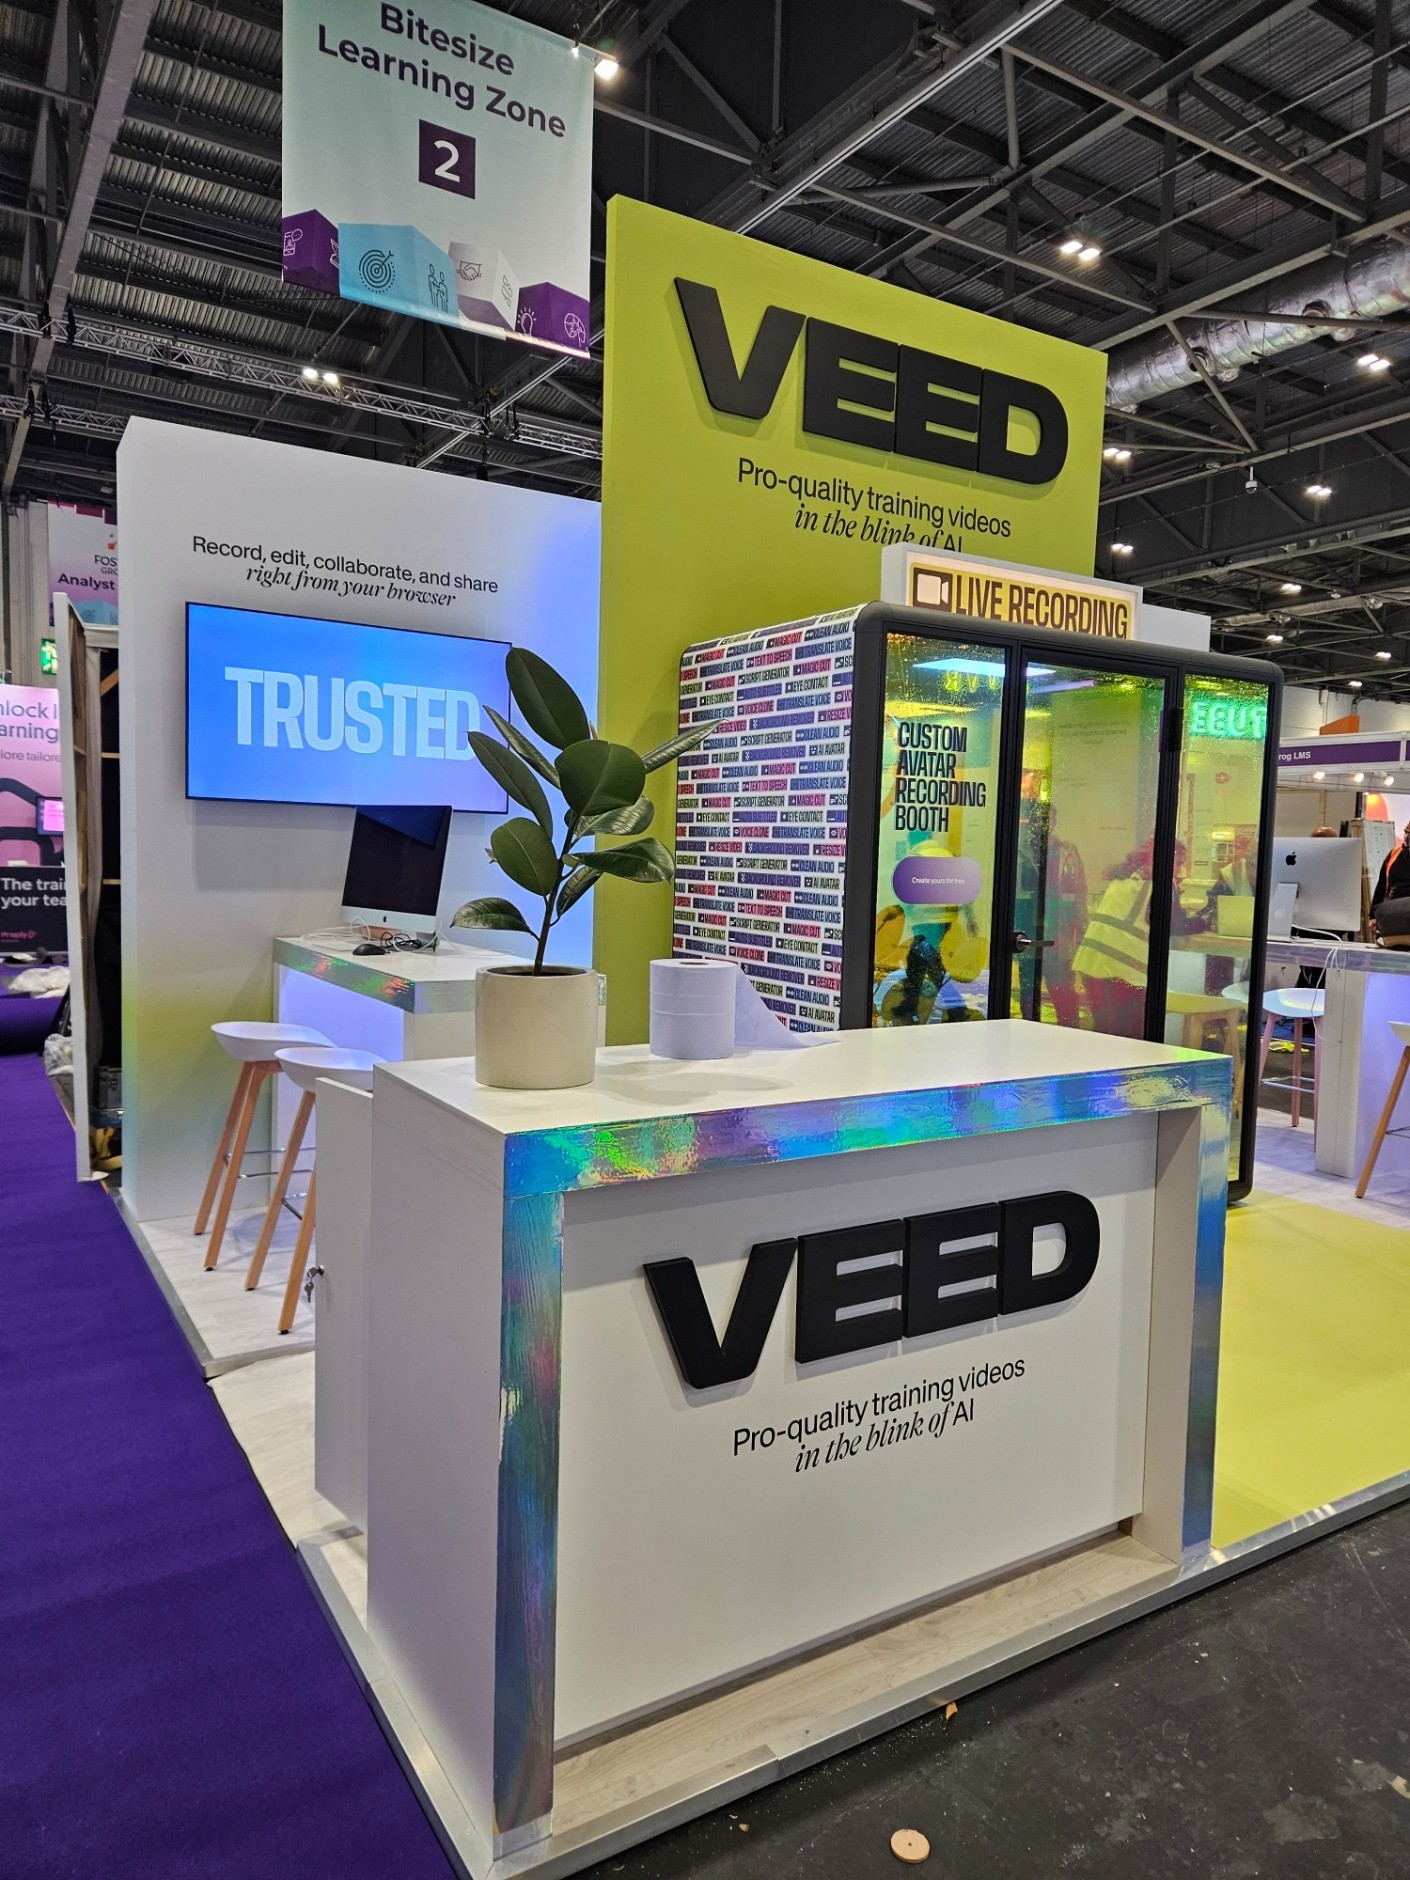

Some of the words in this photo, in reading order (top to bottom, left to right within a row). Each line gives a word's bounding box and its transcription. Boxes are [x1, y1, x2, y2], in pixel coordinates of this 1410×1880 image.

[381, 2, 514, 76] Bitesize
[318, 24, 474, 110] Learning
[486, 84, 566, 138] Zone
[434, 140, 460, 183] 2
[674, 277, 1068, 485] VEED
[738, 457, 864, 511] Pro-quality
[868, 486, 944, 528] training
[948, 506, 1011, 537] videos
[795, 504, 818, 531] in
[824, 510, 856, 538] the
[861, 516, 914, 546] blink
[920, 530, 944, 548] of
[944, 534, 962, 553] AI
[58, 574, 116, 590] Analyst
[193, 536, 266, 562] Record,
[270, 550, 310, 568] edit,
[314, 556, 416, 584] collaborate,
[420, 569, 450, 586] and
[454, 574, 498, 593] share
[246, 566, 291, 588] right
[292, 571, 338, 592] from
[338, 582, 384, 597] your
[387, 583, 456, 606] browser
[956, 574, 1002, 620] LIVE
[1008, 584, 1128, 640] RECORDING
[224, 666, 480, 761] TRUSTED
[898, 722, 968, 752] CUSTOM
[897, 750, 956, 778] AVATAR
[1294, 752, 1311, 760] LMS
[896, 777, 986, 807] RECORDING
[896, 805, 949, 832] BOOTH
[0, 878, 32, 890] The
[0, 896, 40, 910] your
[642, 1190, 1100, 1389] VEED
[733, 1397, 868, 1456] Pro-quality
[872, 1375, 954, 1414] training
[958, 1359, 1025, 1391] videos
[795, 1444, 820, 1473] in
[826, 1430, 860, 1460] the
[866, 1411, 924, 1453] blink
[928, 1402, 956, 1438] of
[952, 1398, 974, 1426] AI
